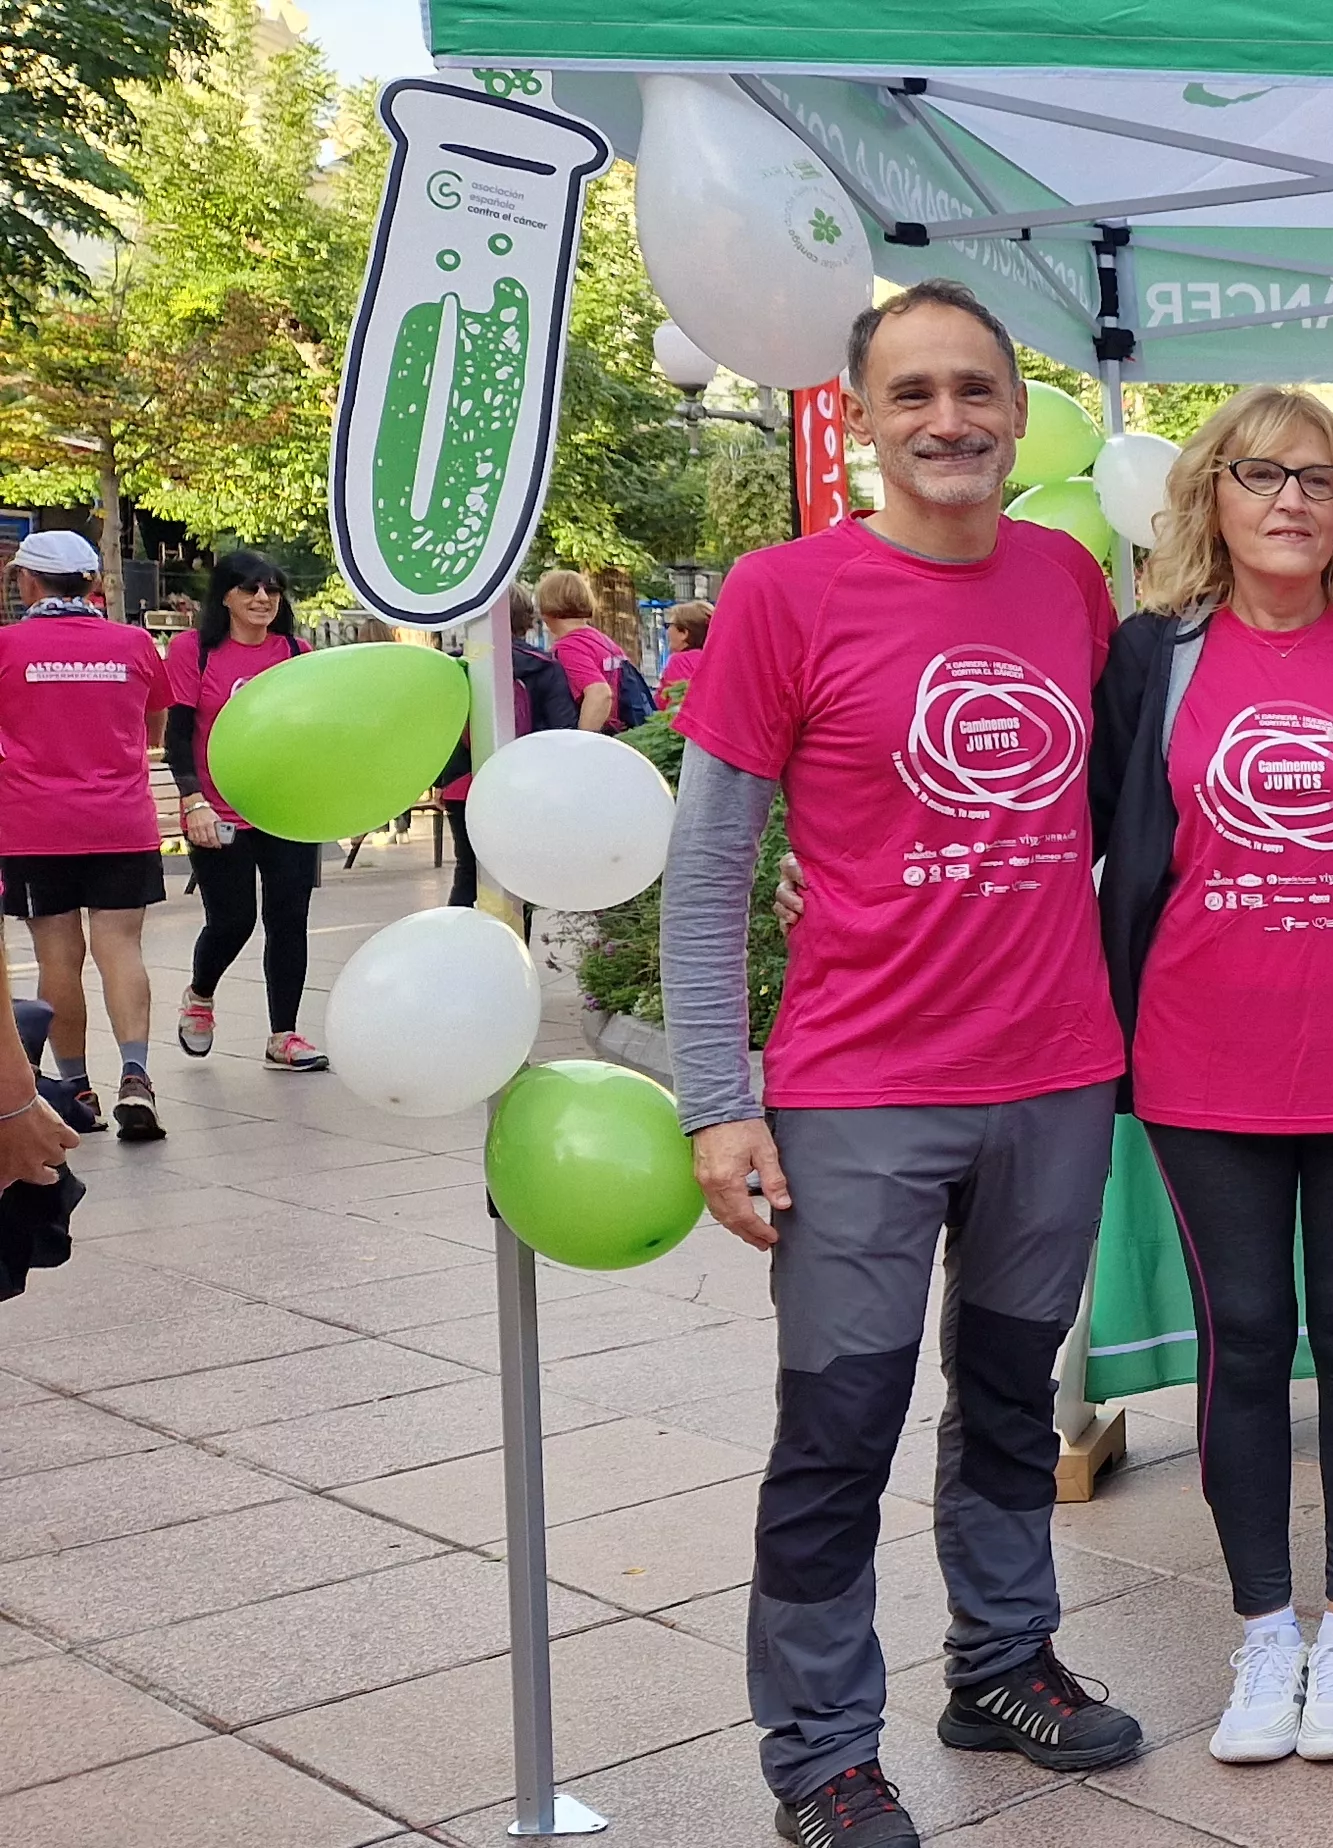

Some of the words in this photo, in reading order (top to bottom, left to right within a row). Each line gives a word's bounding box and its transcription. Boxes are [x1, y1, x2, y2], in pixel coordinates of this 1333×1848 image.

[471, 181, 525, 200] asociación
[469, 193, 516, 210] española
[467, 204, 500, 219] contra
[502, 212, 511, 222] el
[513, 214, 548, 230] cáncer
[26, 660, 127, 672] ALTOARAGÓN
[960, 717, 1020, 734] Caminemos
[966, 733, 1019, 752] JUNTOS
[1258, 759, 1325, 773] Caminemos
[1264, 774, 1322, 790] JUNTOS
